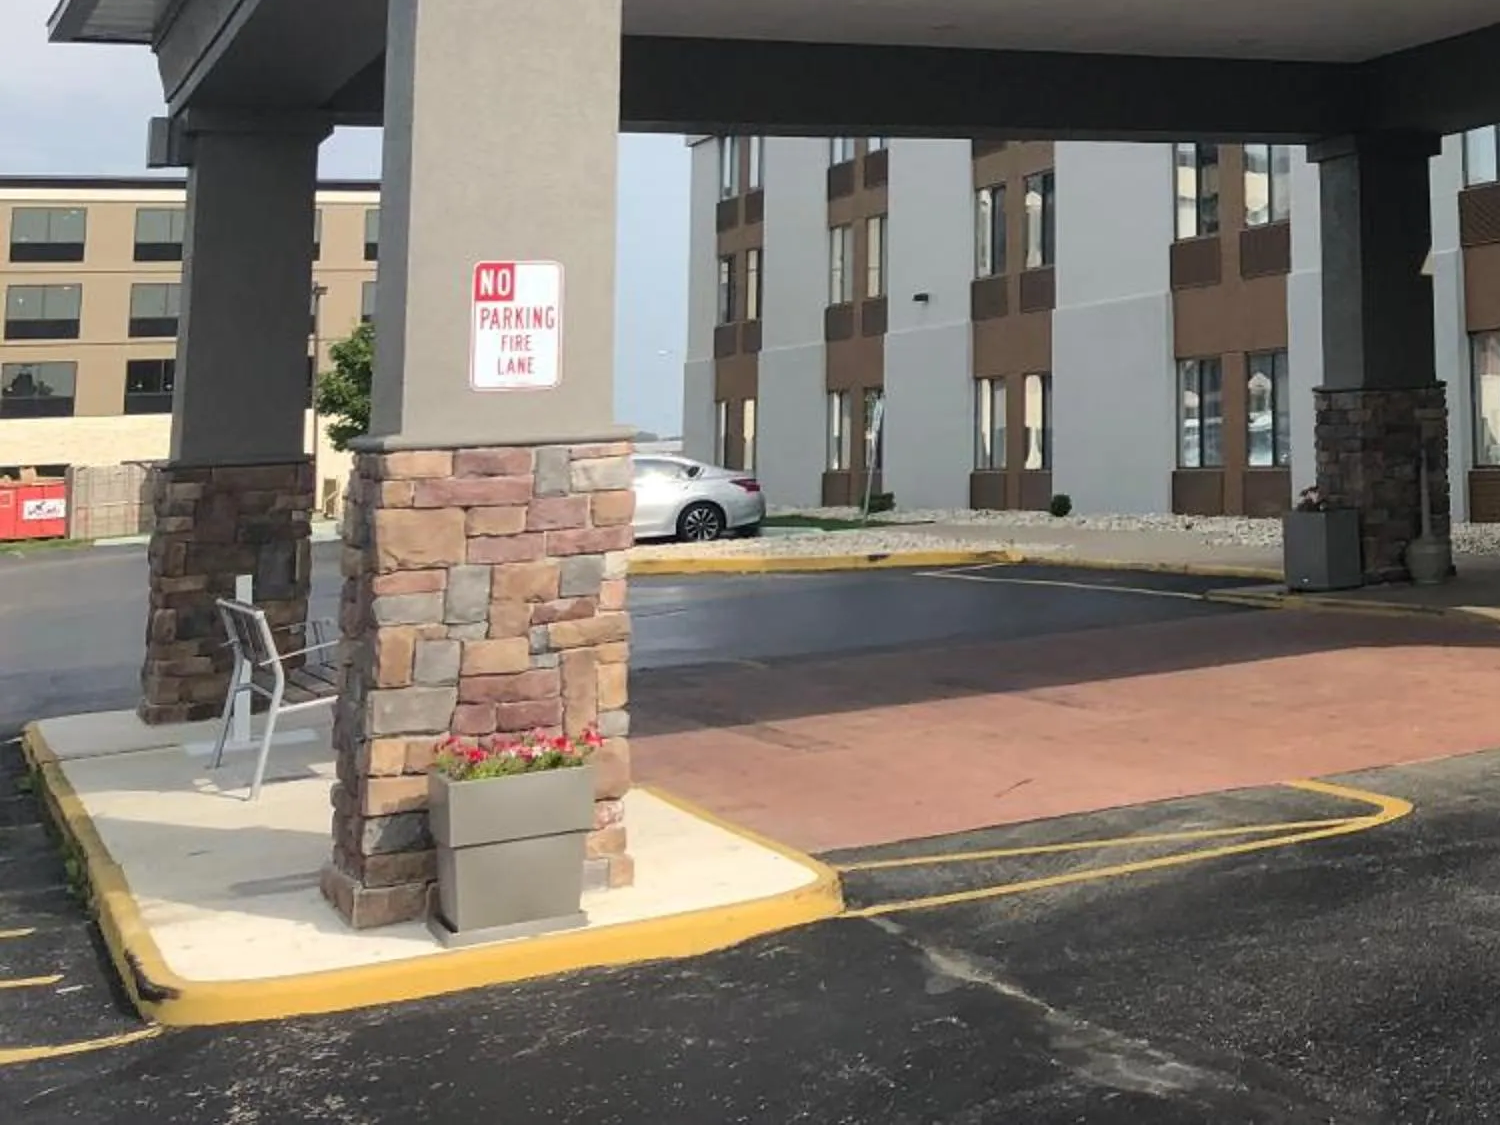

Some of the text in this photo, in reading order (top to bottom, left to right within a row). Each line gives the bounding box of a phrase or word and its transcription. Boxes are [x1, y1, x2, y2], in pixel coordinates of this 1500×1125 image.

[480, 268, 512, 296] NO
[480, 306, 555, 330] PARKING
[501, 334, 533, 352] FIRE
[497, 356, 536, 376] LANE
